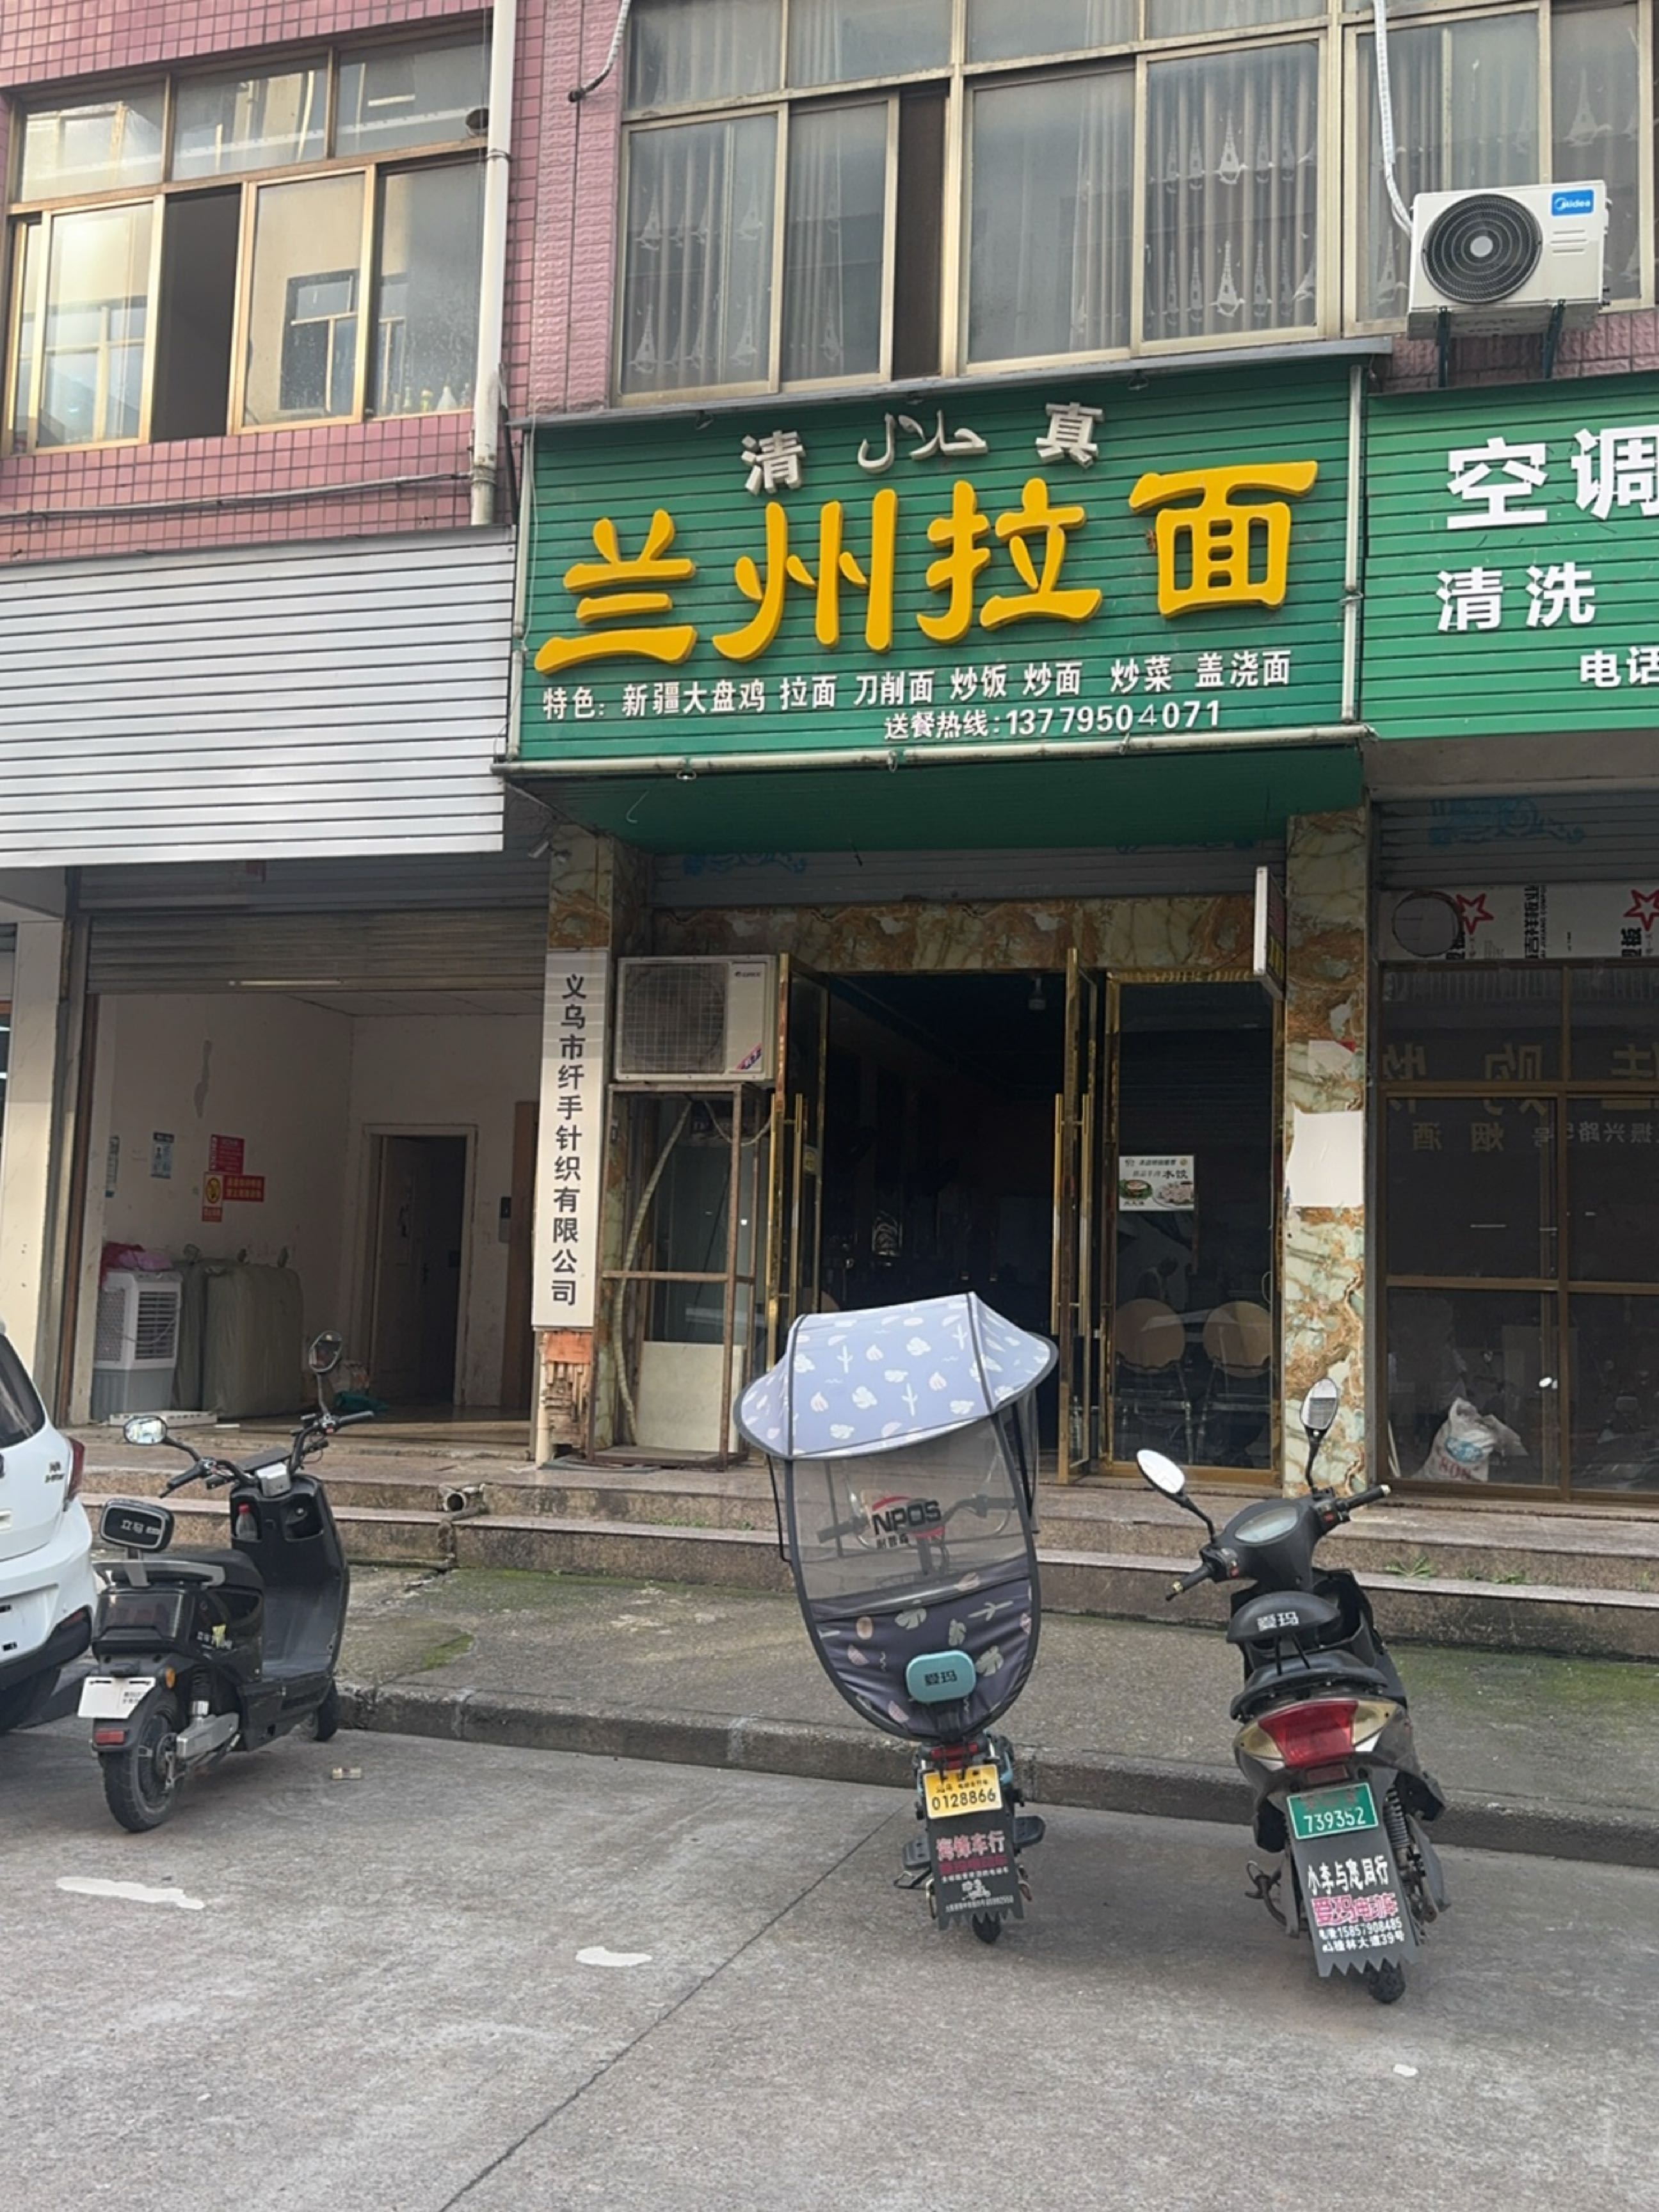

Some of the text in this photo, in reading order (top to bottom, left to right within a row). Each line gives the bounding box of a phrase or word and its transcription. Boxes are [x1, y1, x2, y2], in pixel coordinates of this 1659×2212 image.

[1555, 198, 1591, 211] Midea
[741, 429, 805, 496] 清
[858, 410, 989, 474] حلال
[1036, 401, 1105, 468] 真
[1447, 424, 1659, 529] 空调
[534, 460, 1318, 675] 兰州拉面
[1436, 561, 1596, 632] 清洗
[621, 678, 765, 717] 新疆大盘鸡
[780, 675, 838, 710] 拉面
[853, 670, 936, 706] 刀削面
[950, 664, 1007, 701] 炒饭
[1023, 661, 1082, 697] 炒面
[1110, 655, 1173, 694] 炒菜
[1195, 649, 1291, 688] 盖浇面
[1580, 646, 1659, 688] 电话
[551, 973, 587, 1306] 义乌市纤手针织有限公司
[872, 1500, 941, 1535] NPOS
[931, 1788, 996, 1811] 0128866
[1303, 1806, 1366, 1834] 739352
